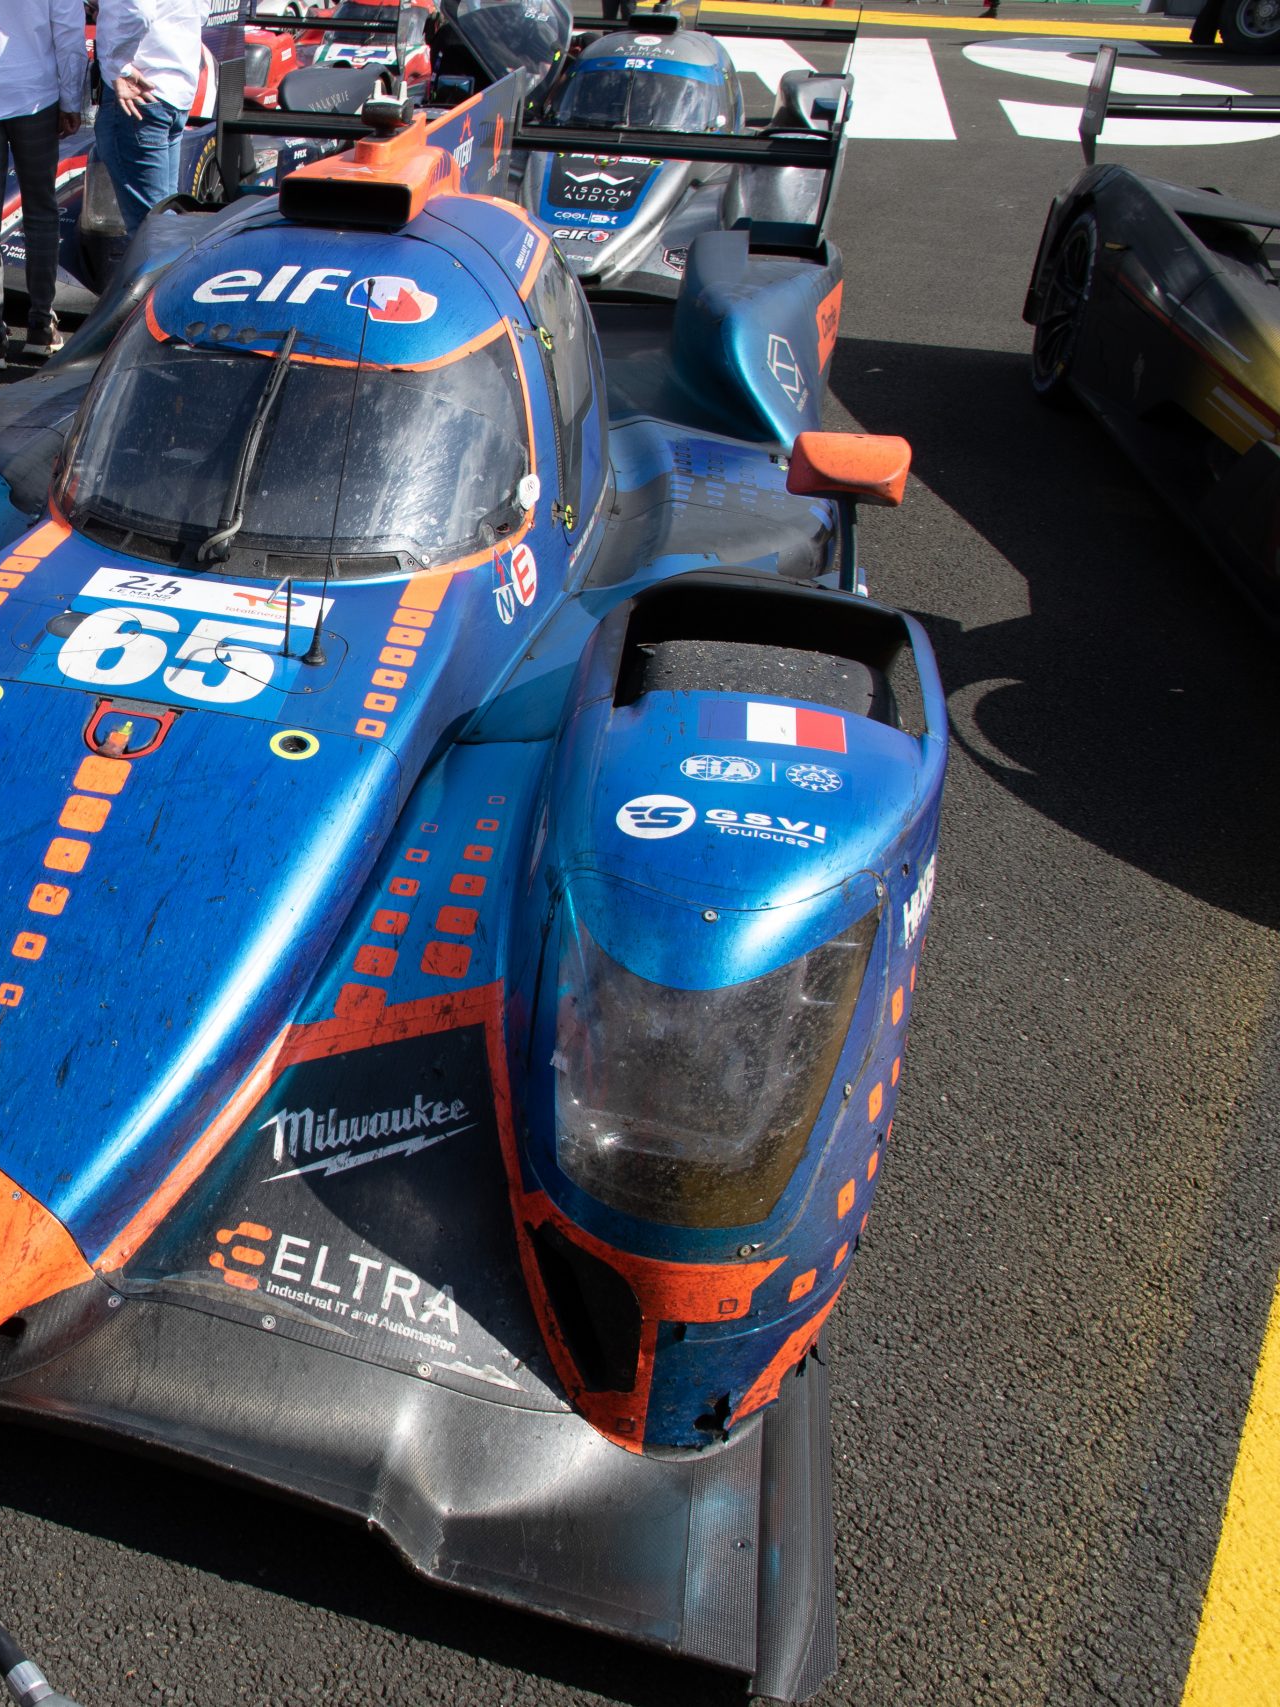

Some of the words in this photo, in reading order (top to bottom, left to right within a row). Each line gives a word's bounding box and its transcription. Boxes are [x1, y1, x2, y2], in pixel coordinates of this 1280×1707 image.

[615, 45, 676, 56] ATMAN
[563, 193, 620, 204] AUDIO
[192, 265, 351, 304] elf
[57, 607, 287, 703] 65
[705, 808, 827, 839] GSVI
[716, 824, 810, 849] Toulouse
[257, 1095, 470, 1163] Milwaukee
[271, 1233, 460, 1336] ELTRA
[266, 1281, 333, 1312] Industrial
[335, 1300, 349, 1316] IT
[351, 1307, 379, 1326] and
[379, 1316, 457, 1354] Automation
